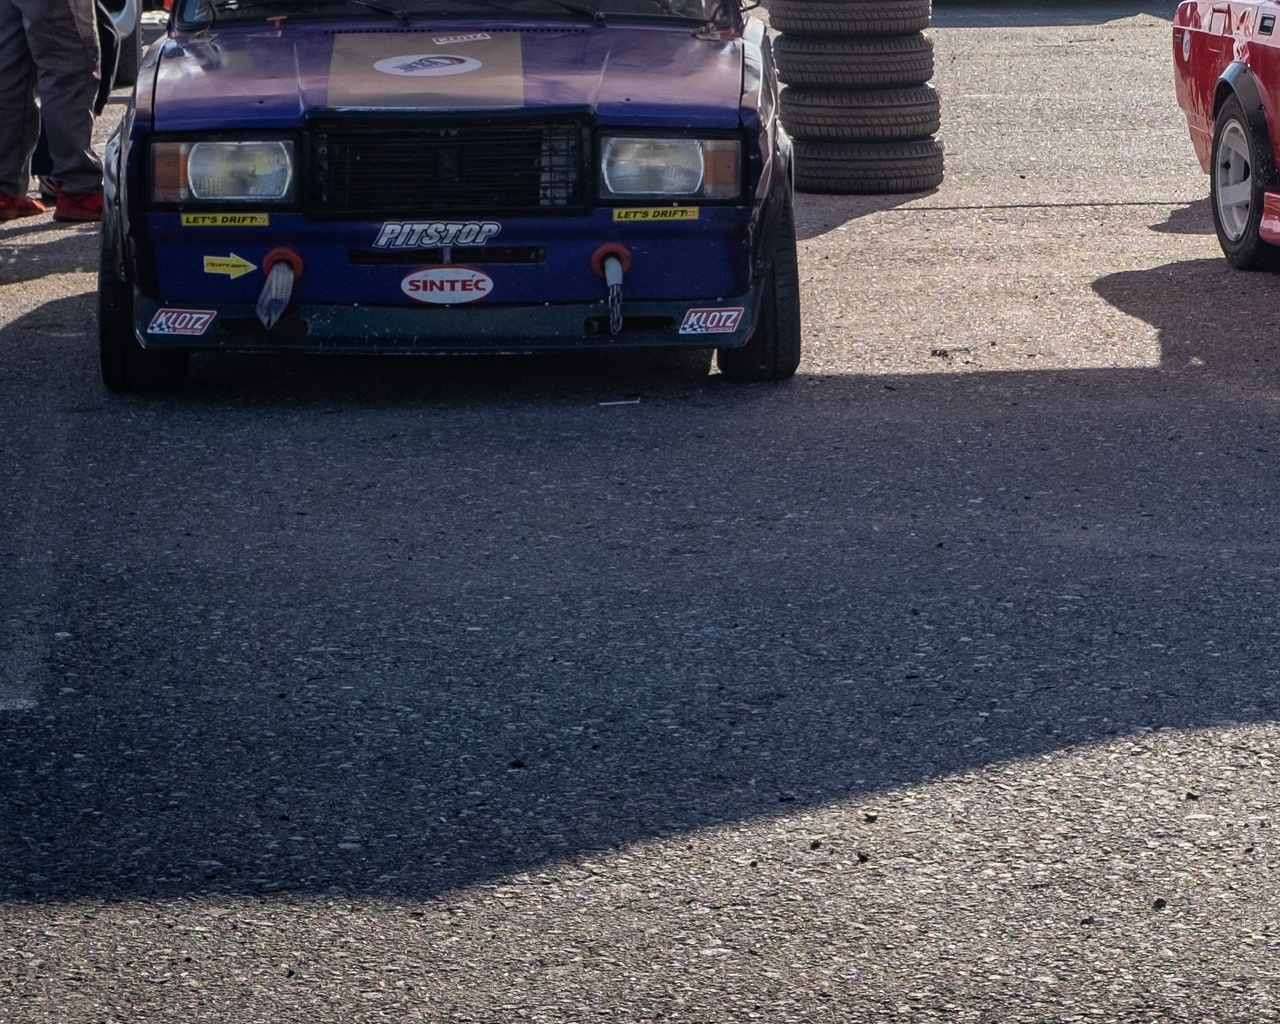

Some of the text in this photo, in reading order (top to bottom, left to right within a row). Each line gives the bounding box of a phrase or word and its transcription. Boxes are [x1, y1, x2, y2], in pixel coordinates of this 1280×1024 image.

[185, 216, 218, 224] LET'S
[616, 210, 650, 219] LET'S
[372, 220, 502, 249] PITSTOP
[407, 278, 487, 293] SINTEC
[156, 312, 211, 329] KLOTZ
[687, 311, 739, 328] KLOTZ
